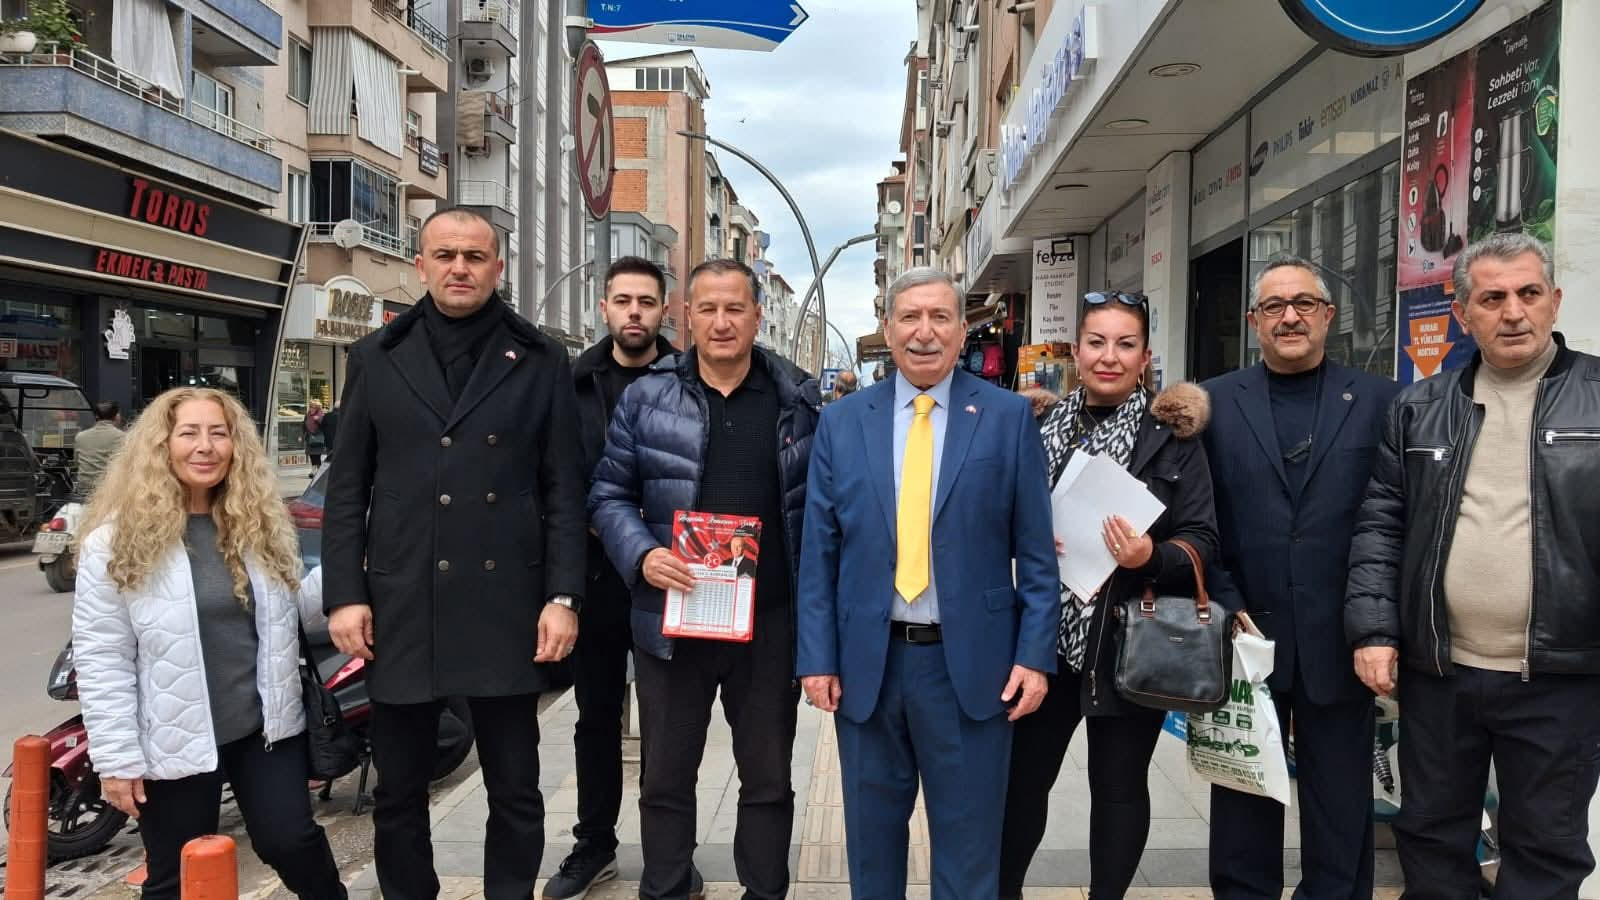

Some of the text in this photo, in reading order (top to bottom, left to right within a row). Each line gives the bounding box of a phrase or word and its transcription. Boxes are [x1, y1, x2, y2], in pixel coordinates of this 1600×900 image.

[1488, 63, 1522, 92] Sohbeti
[1320, 96, 1346, 128] emsan
[1350, 75, 1378, 106] KORKMAZ
[1488, 83, 1519, 110] Lezzeti
[130, 178, 210, 236] TOROS
[96, 249, 152, 280] EKMEK
[167, 265, 208, 289] PASTA
[1036, 249, 1075, 266] feyza
